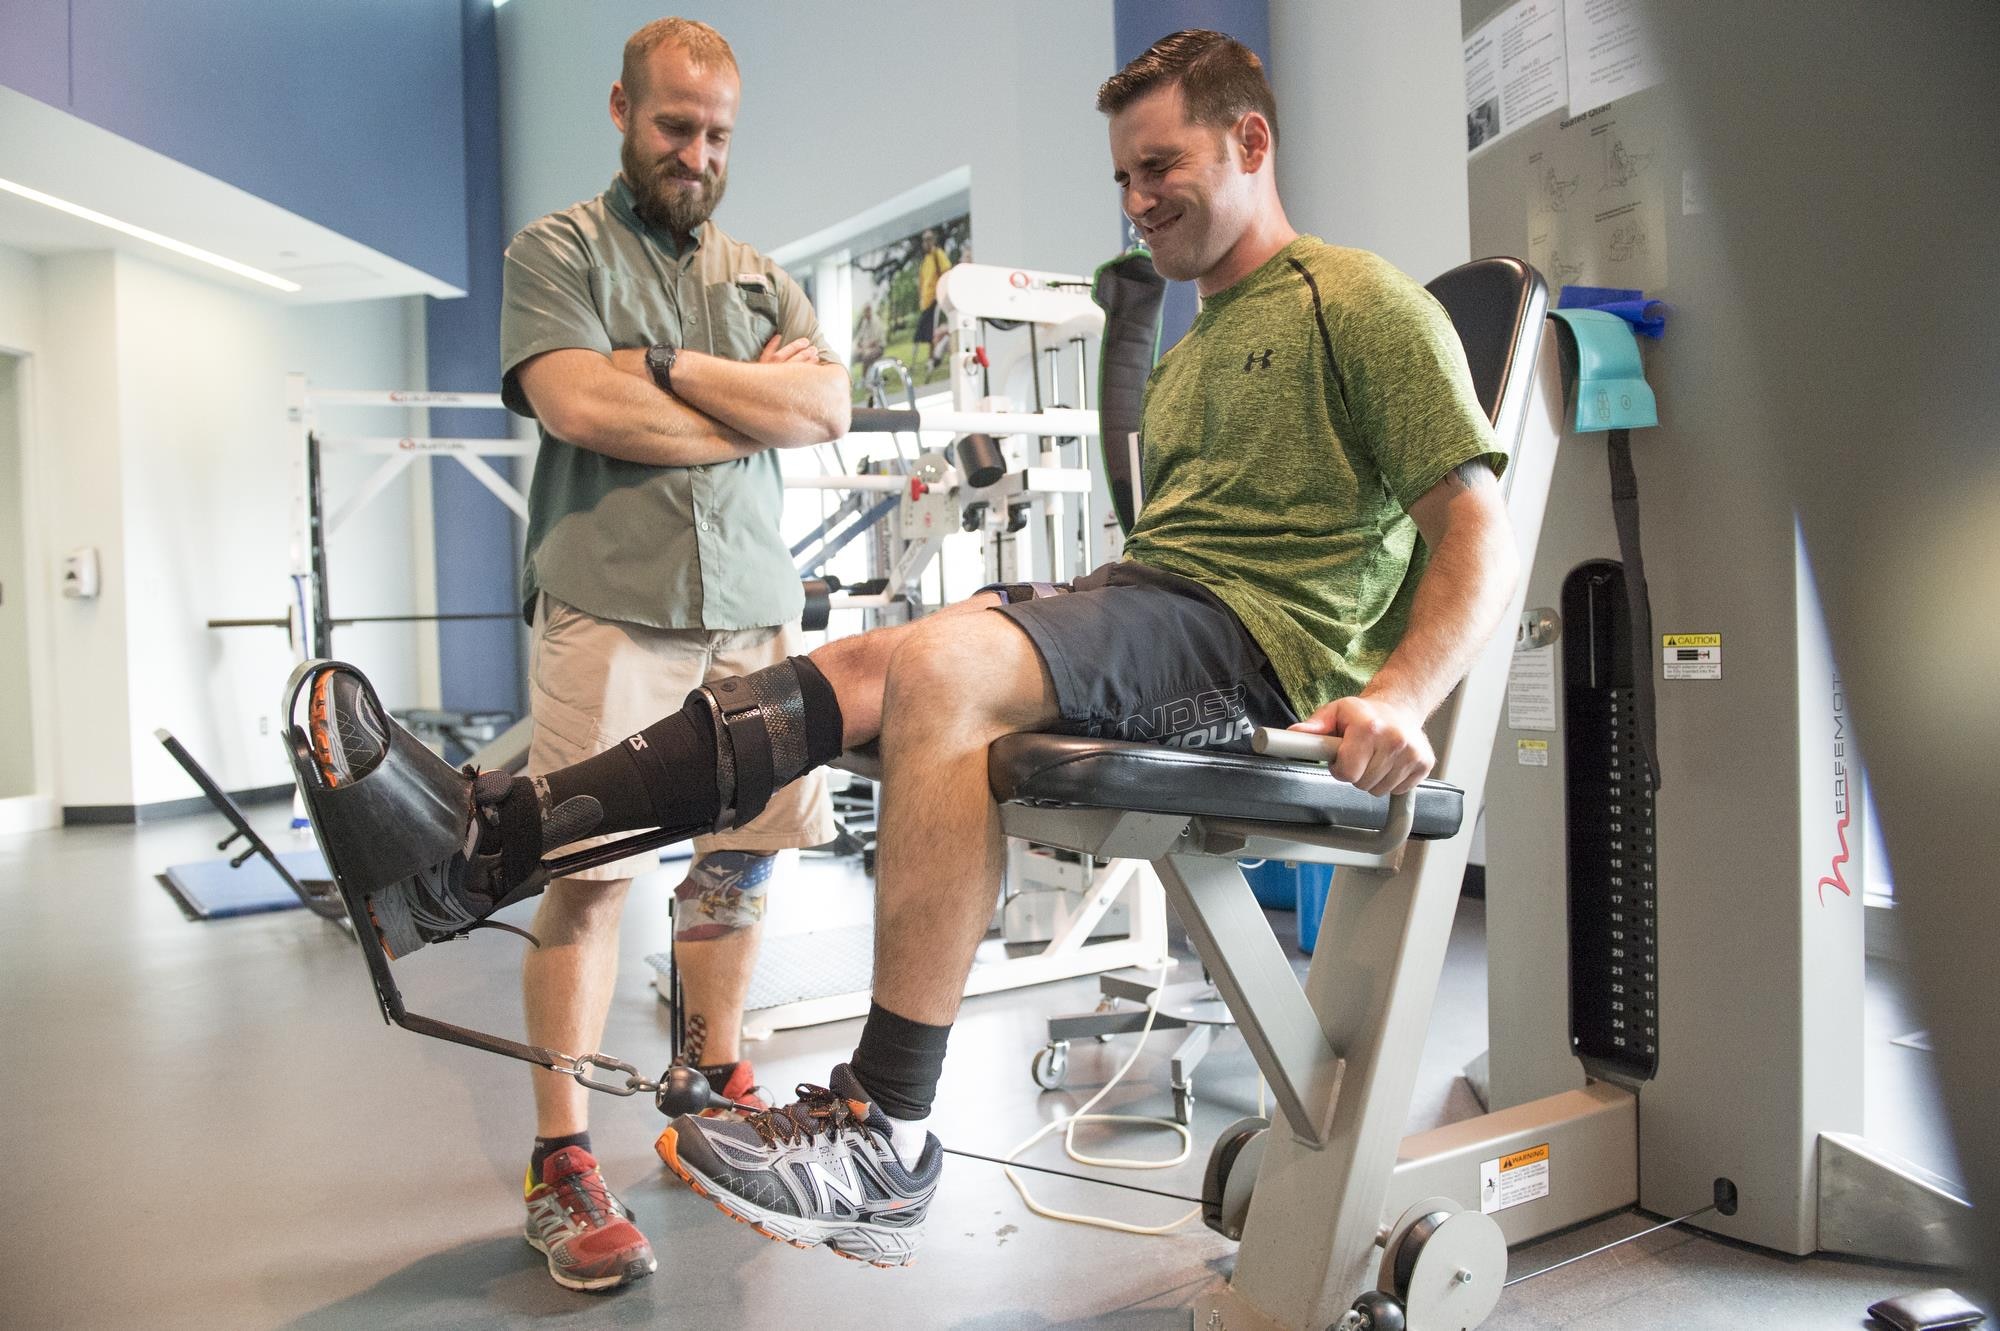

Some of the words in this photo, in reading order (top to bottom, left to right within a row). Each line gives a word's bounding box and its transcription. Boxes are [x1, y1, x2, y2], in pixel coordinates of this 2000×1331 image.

[1677, 636, 1717, 645] CAUTION
[1611, 690, 1618, 698] 4
[1117, 683, 1247, 741] NDER
[1611, 703, 1618, 712] 5
[1163, 716, 1256, 749] OUR
[1612, 731, 1618, 739] 7
[1832, 672, 1846, 815] FREEMOT
[1612, 758, 1618, 767] 9
[1610, 771, 1621, 780] 10
[1610, 787, 1621, 796] 11
[1610, 805, 1621, 814] 12
[1610, 823, 1622, 832] 13
[1611, 841, 1622, 850] 14
[1611, 859, 1622, 868] 15
[1611, 877, 1622, 886] 16
[1611, 895, 1622, 904] 17
[1611, 913, 1622, 922] 18
[1612, 931, 1623, 940] 19
[1612, 949, 1623, 957] 20
[1612, 966, 1622, 975] 21
[1612, 984, 1624, 993] 22
[1612, 1002, 1623, 1011] 23
[1613, 1019, 1624, 1028] 24
[1614, 1037, 1625, 1046] 25
[1512, 1149, 1545, 1164] WARNING
